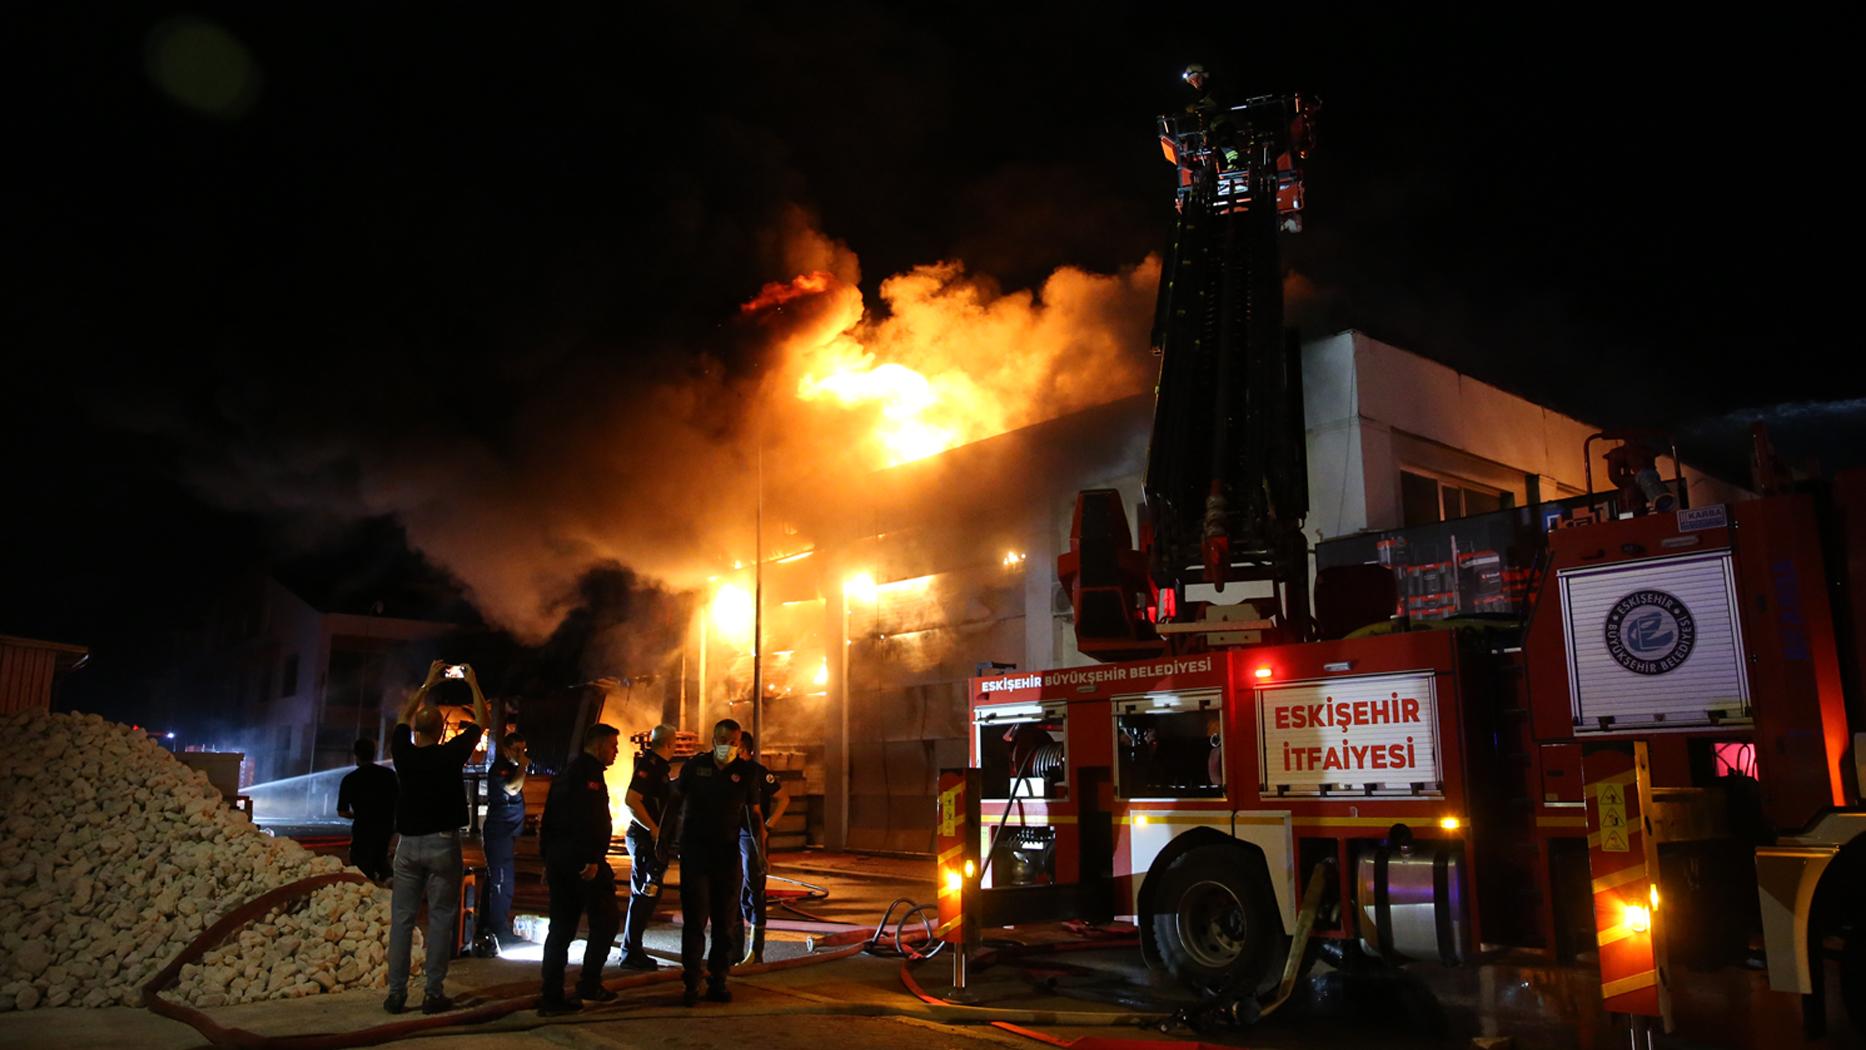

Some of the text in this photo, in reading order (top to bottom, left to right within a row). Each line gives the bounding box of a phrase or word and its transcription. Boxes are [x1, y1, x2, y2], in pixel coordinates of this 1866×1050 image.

[981, 657, 1212, 693] ESKİŞEHİR BÜYÜKŞEHİR BELEDİYESİ
[1275, 692, 1421, 733] ESKİŞEHİR
[1283, 736, 1416, 771] İTFAİYESİ
